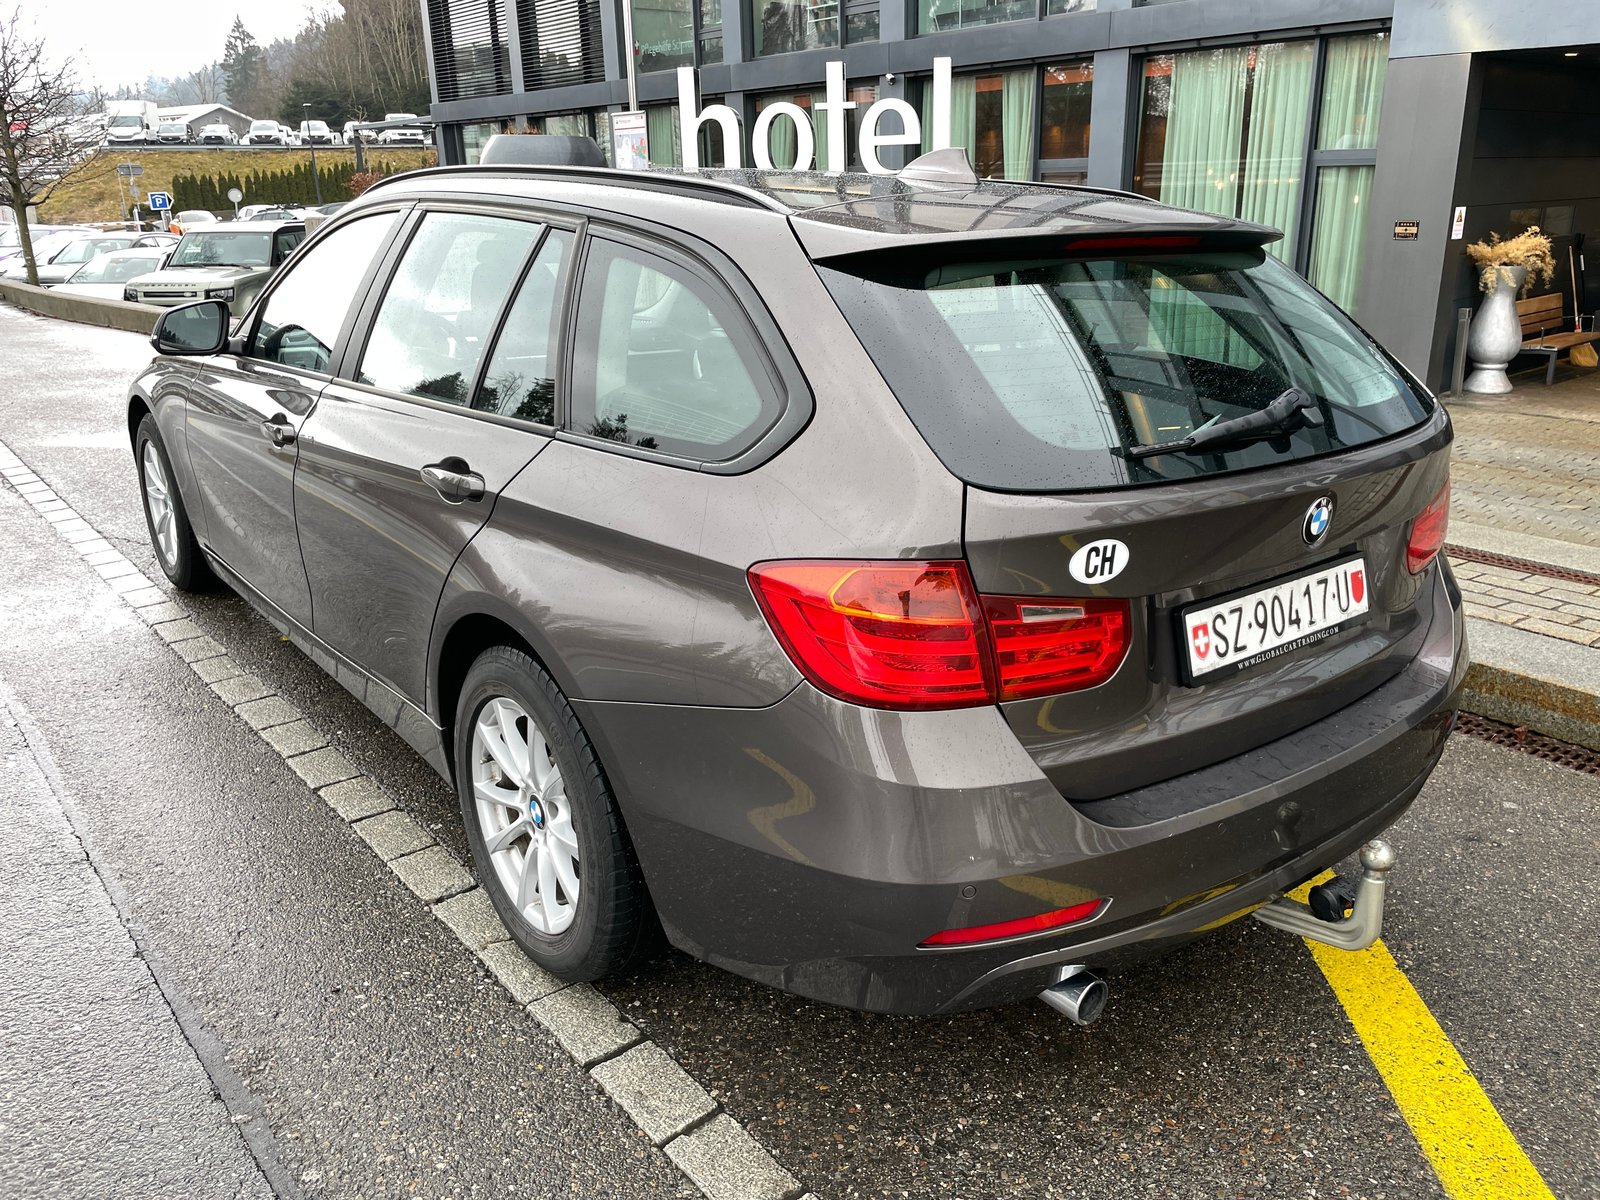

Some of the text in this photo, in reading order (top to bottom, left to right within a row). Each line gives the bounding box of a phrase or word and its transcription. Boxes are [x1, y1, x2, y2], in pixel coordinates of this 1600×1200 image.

[677, 57, 952, 175] hotel
[155, 197, 163, 207] P
[1085, 544, 1117, 579] CH
